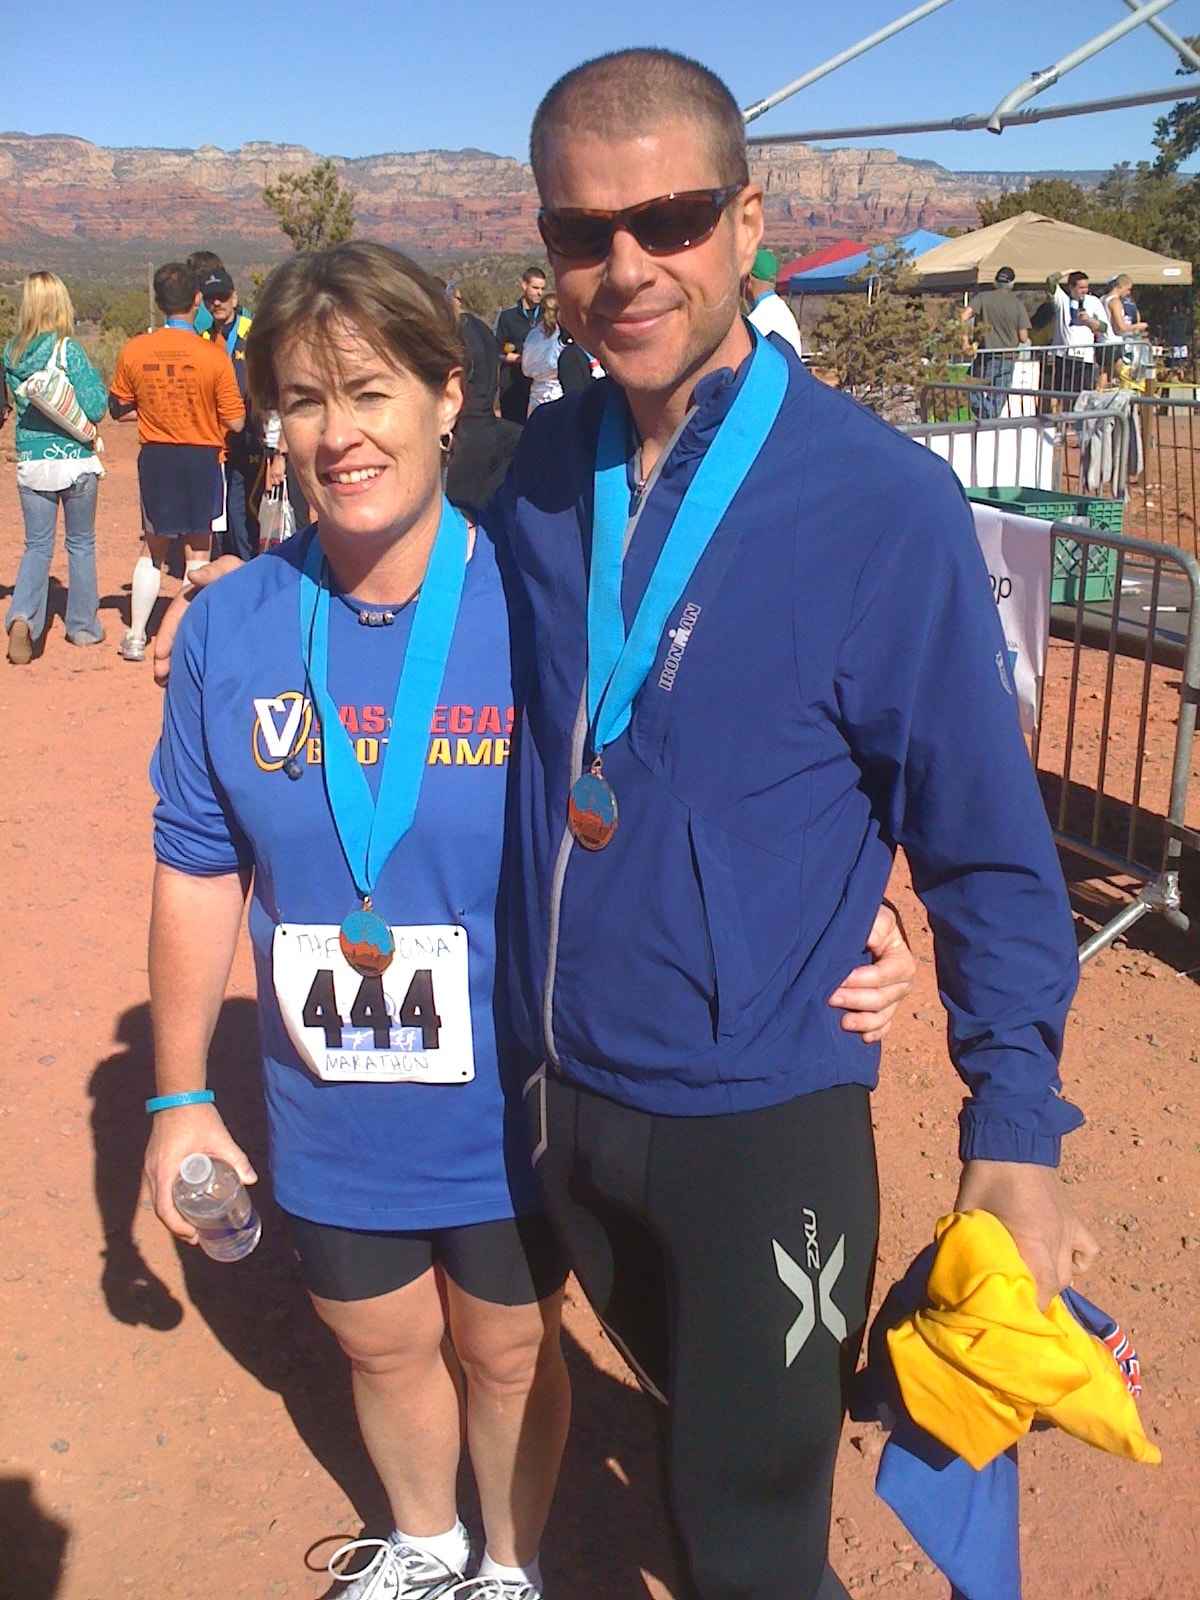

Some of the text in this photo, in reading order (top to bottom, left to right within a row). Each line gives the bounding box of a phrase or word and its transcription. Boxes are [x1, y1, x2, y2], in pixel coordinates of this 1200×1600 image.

[658, 602, 702, 692] IRONMAN
[314, 705, 386, 735] AS
[307, 736, 511, 766] BO AMP
[302, 968, 442, 1050] 444
[325, 1053, 430, 1073] MARATHON
[802, 1207, 821, 1270] 2XU
